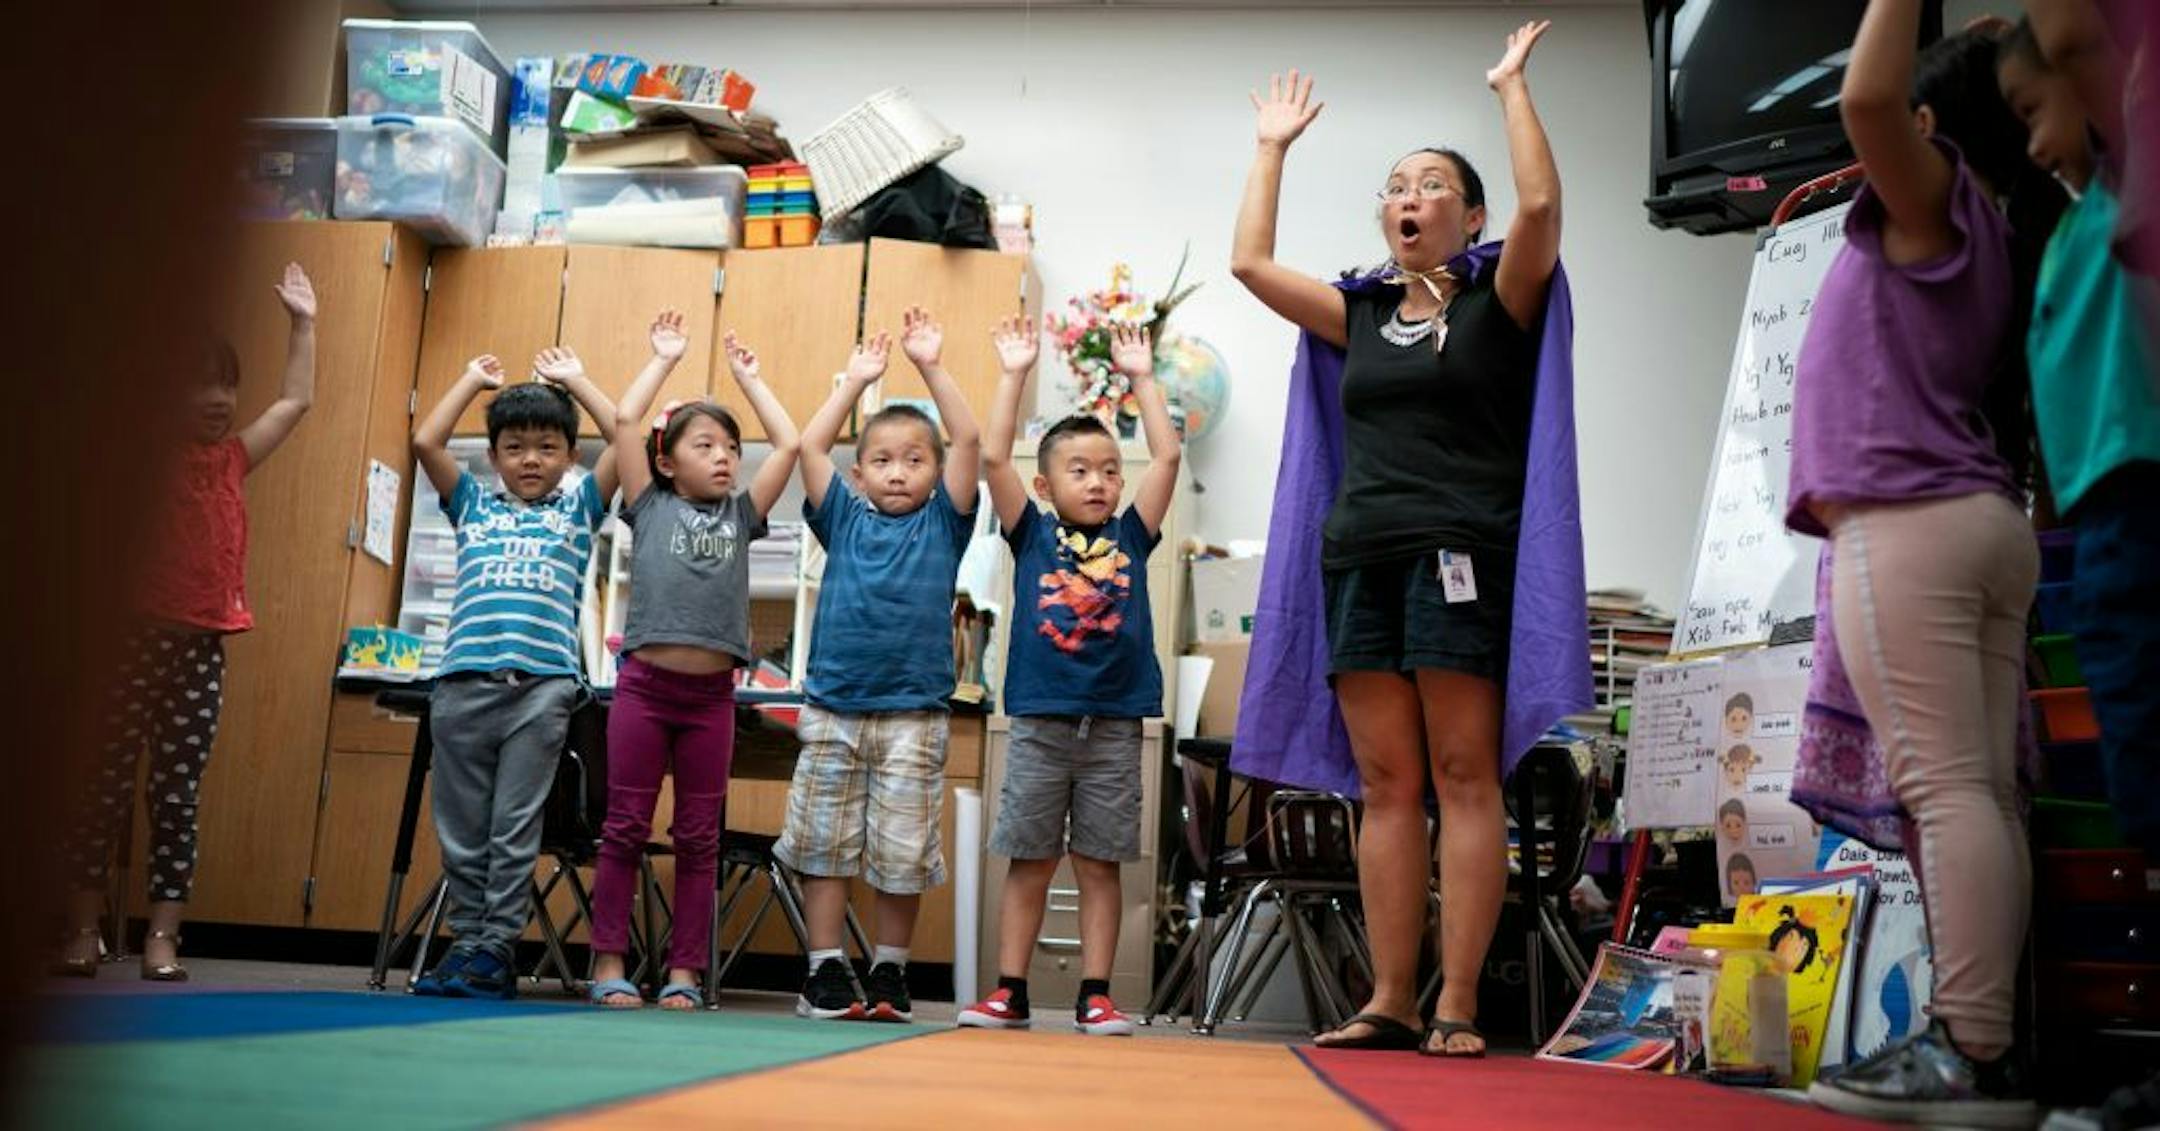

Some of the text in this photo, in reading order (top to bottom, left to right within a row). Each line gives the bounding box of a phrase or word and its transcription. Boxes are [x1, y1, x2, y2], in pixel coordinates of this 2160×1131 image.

[1768, 138, 1786, 150] JVC
[503, 537, 542, 559] ON
[670, 530, 735, 559] IS YOUR
[478, 560, 556, 592] FIELD
[1839, 847, 1909, 861] Dais Daw
